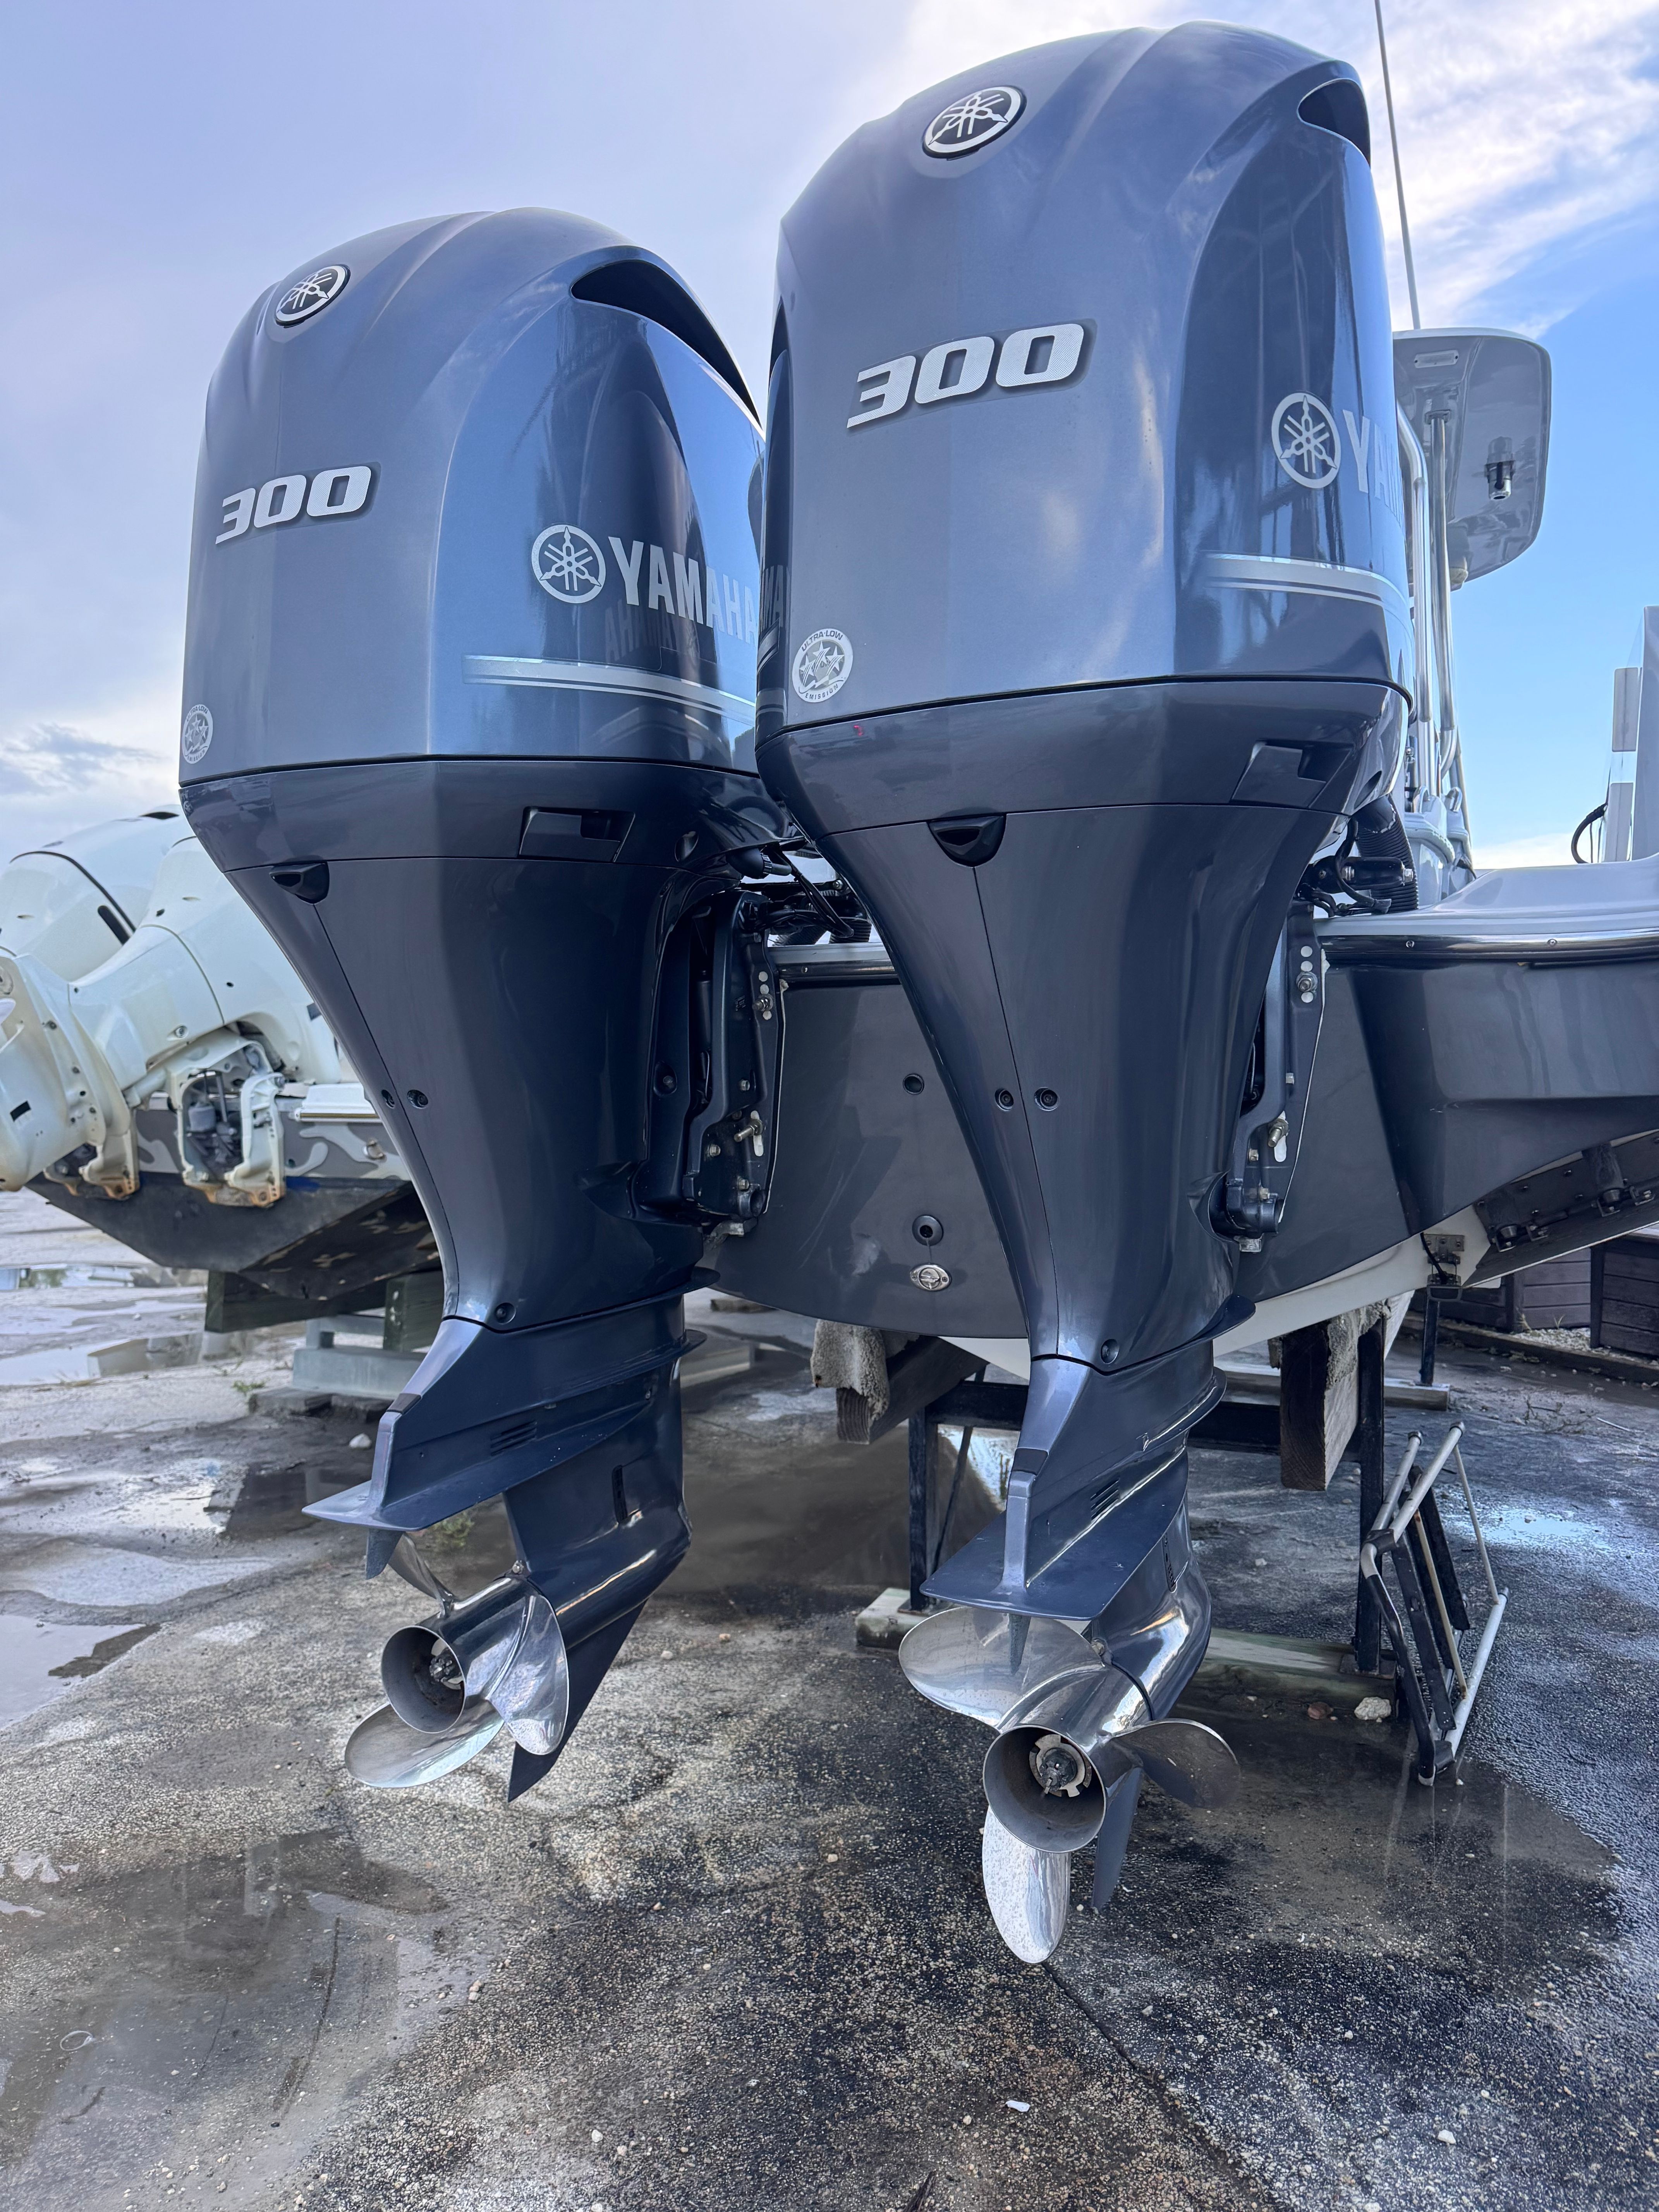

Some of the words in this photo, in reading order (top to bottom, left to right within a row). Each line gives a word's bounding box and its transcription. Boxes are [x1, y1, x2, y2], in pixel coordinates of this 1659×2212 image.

[847, 323, 1084, 428] 300
[215, 466, 371, 544] 300
[608, 536, 757, 644] YAMAHA
[805, 684, 838, 700] EMISSION
